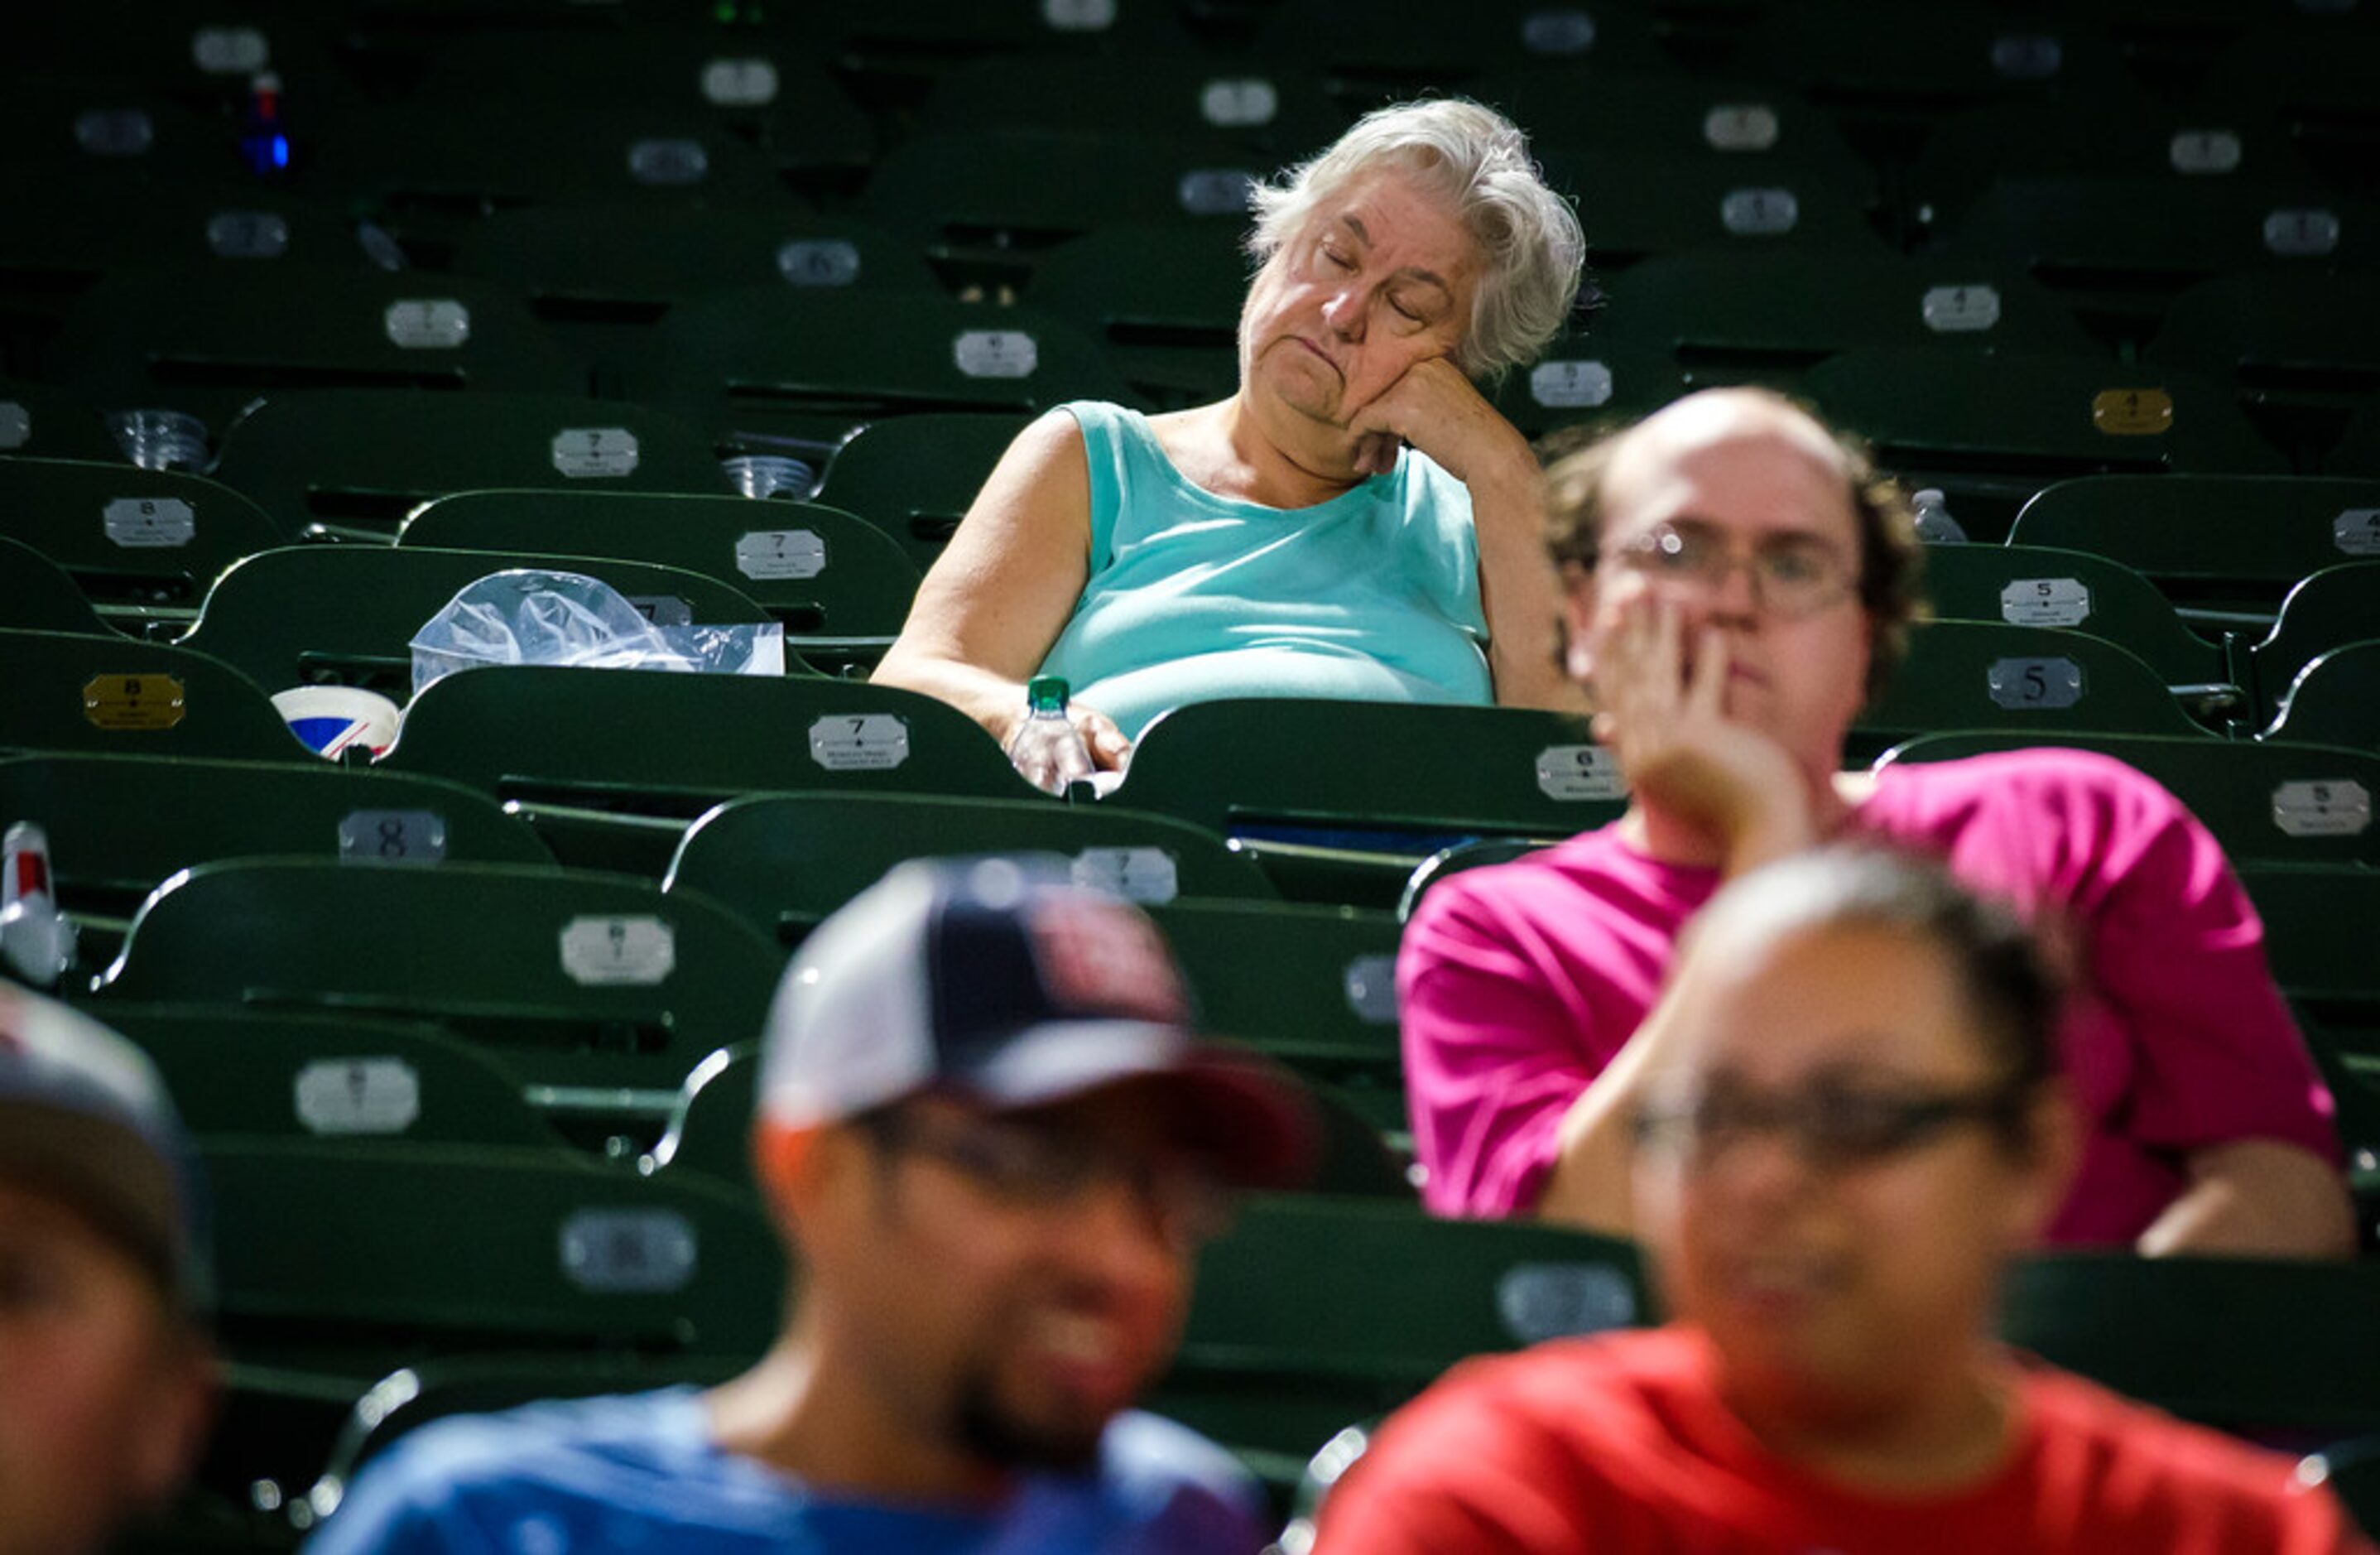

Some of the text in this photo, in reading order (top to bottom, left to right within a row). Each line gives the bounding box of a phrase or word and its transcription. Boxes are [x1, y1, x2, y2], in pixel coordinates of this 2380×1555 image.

[587, 433, 602, 446] 7
[140, 501, 156, 514] 8
[769, 534, 785, 547] 7
[2037, 583, 2051, 596] 5
[124, 679, 141, 694] 8
[2024, 666, 2046, 700] 5
[847, 719, 864, 734] 7
[1576, 750, 1594, 766] 6
[377, 817, 406, 859] 8
